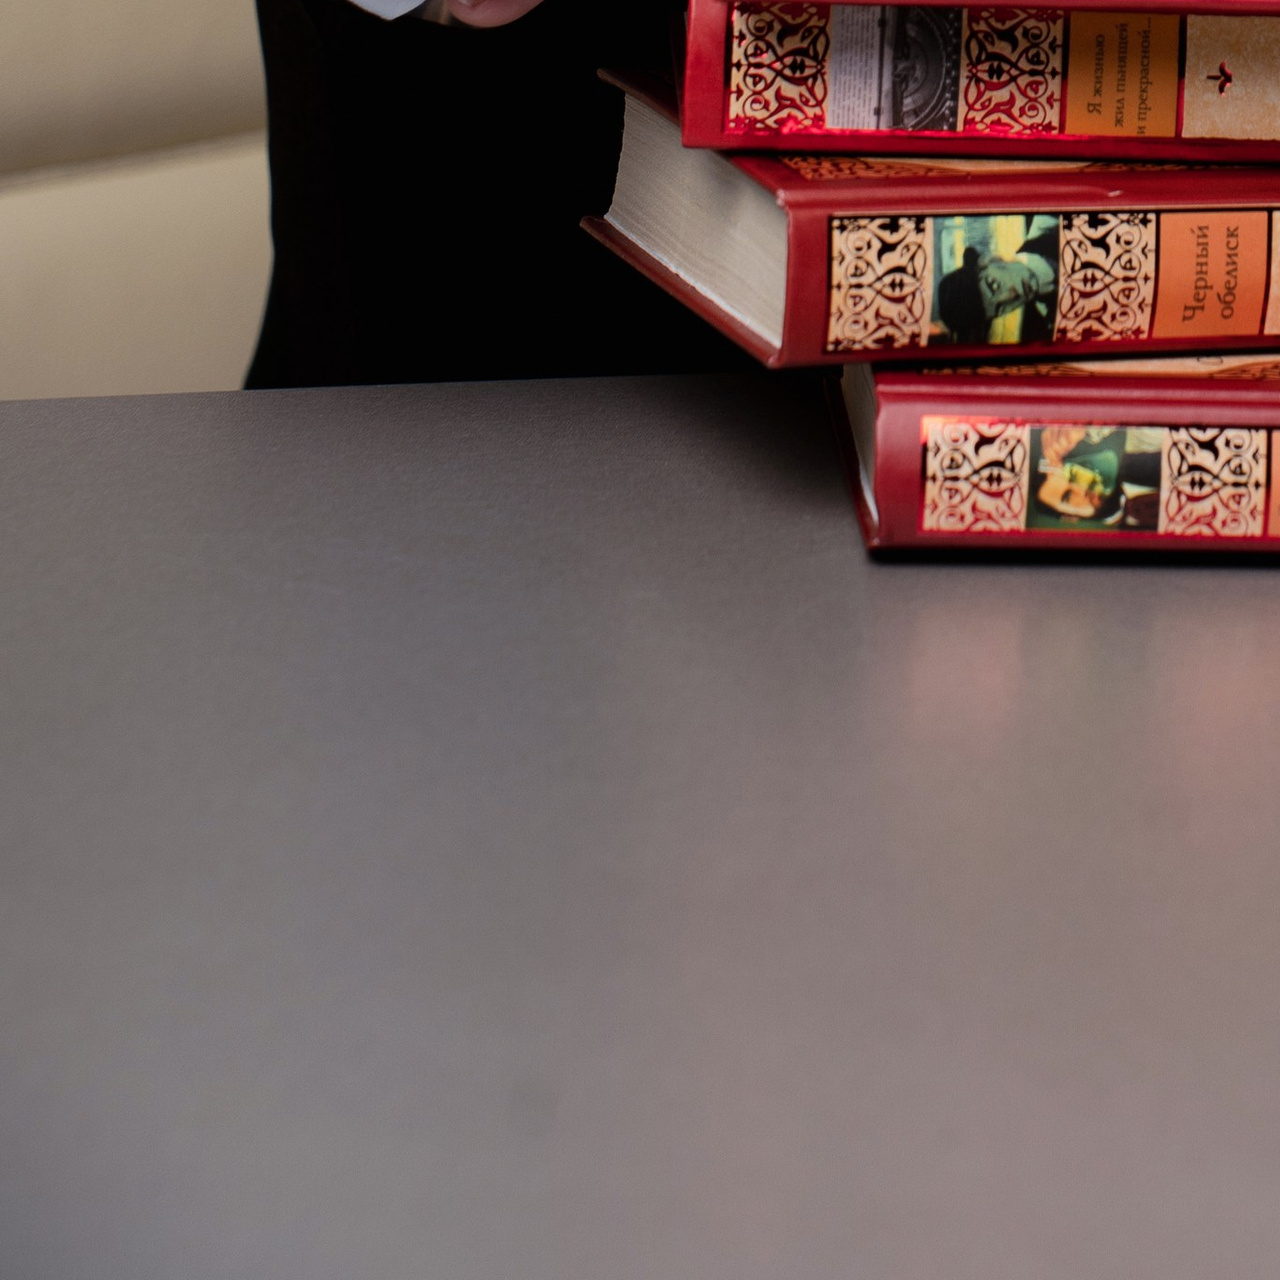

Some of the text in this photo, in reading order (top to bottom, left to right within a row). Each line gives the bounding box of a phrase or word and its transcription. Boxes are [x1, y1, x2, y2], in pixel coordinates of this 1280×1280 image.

[1087, 33, 1106, 116] Я жизнью
[1115, 98, 1125, 128] жил
[1137, 125, 1146, 135] и
[1181, 225, 1213, 322] Черный
[1217, 225, 1239, 320] обелиск
